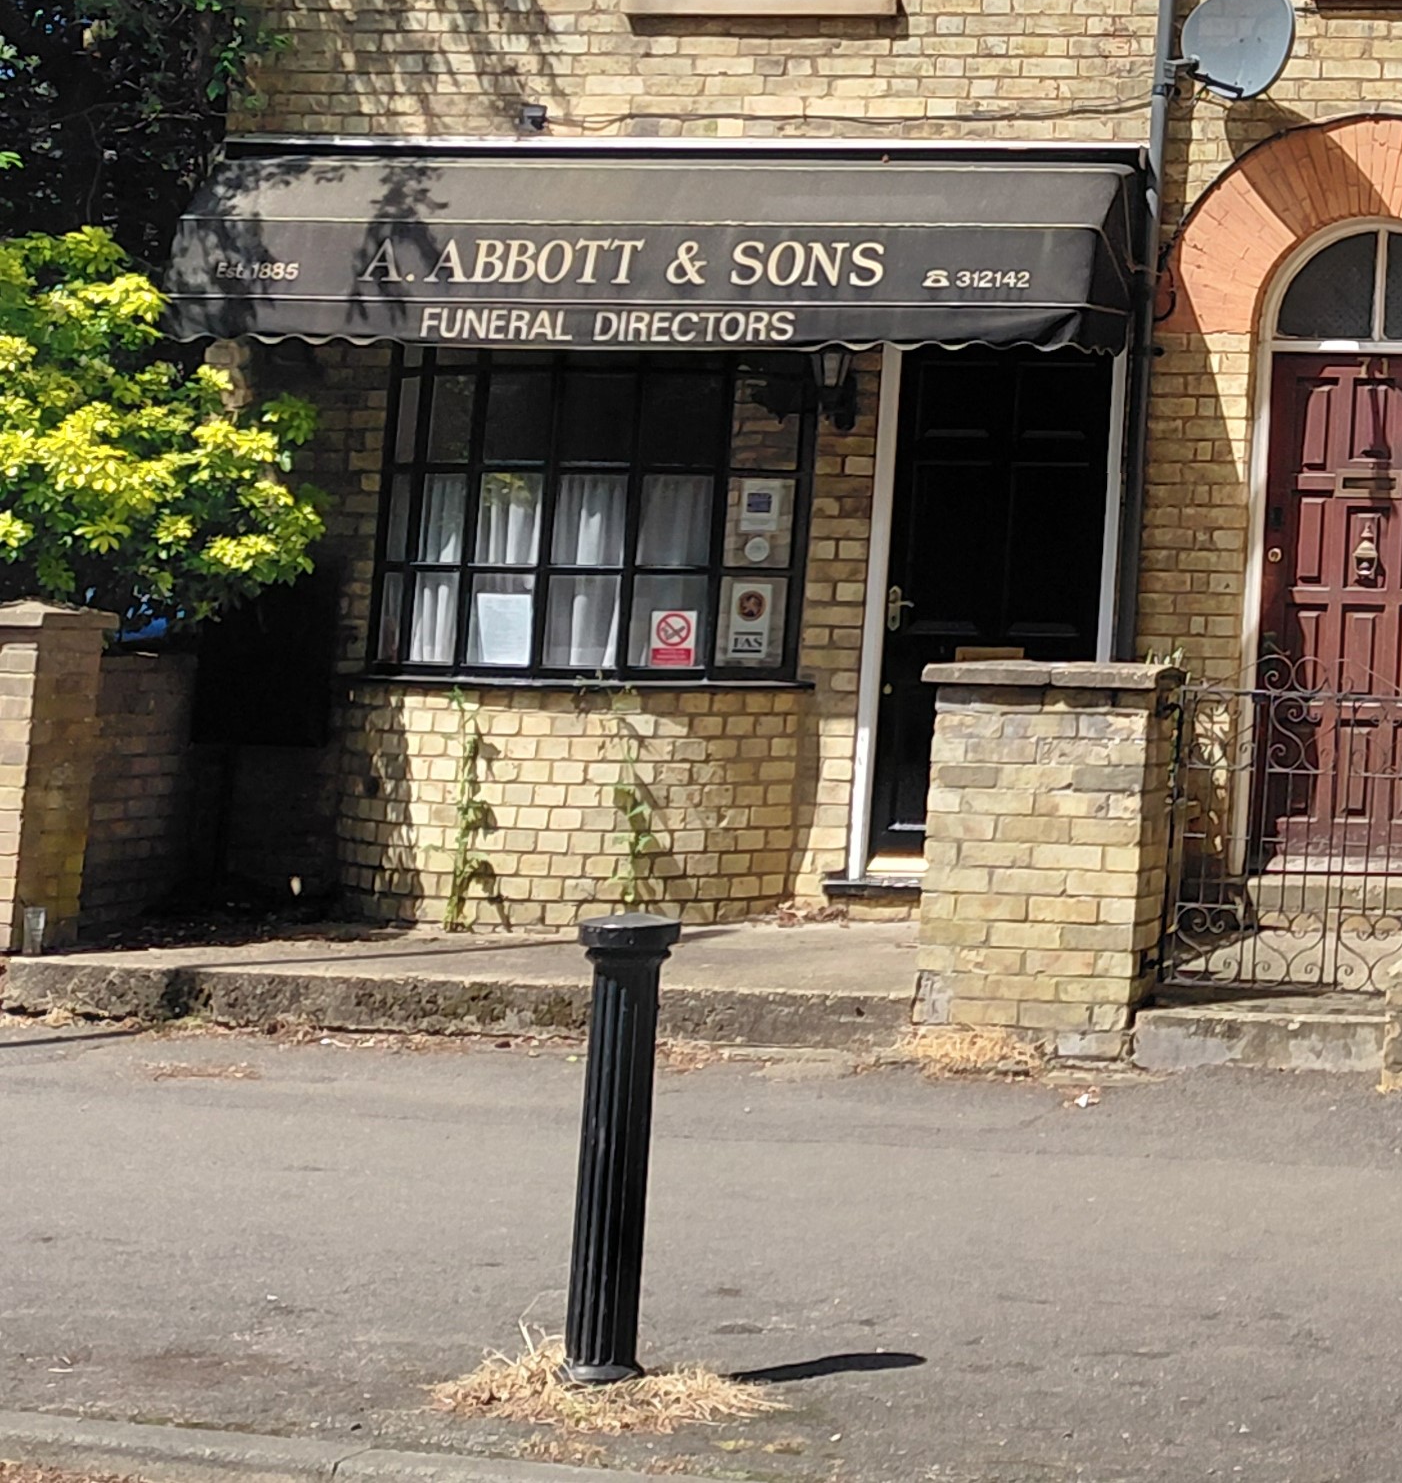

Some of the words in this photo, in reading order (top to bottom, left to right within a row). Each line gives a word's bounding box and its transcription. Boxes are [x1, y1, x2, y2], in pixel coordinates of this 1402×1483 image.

[251, 261, 300, 281] 1885
[360, 238, 416, 283] A.
[423, 237, 646, 284] ABBOTT
[666, 240, 707, 285] &
[730, 240, 886, 287] SONS
[955, 270, 1031, 288] 312142
[419, 307, 573, 341] FUNERAL
[593, 311, 797, 343] DIRECTORS
